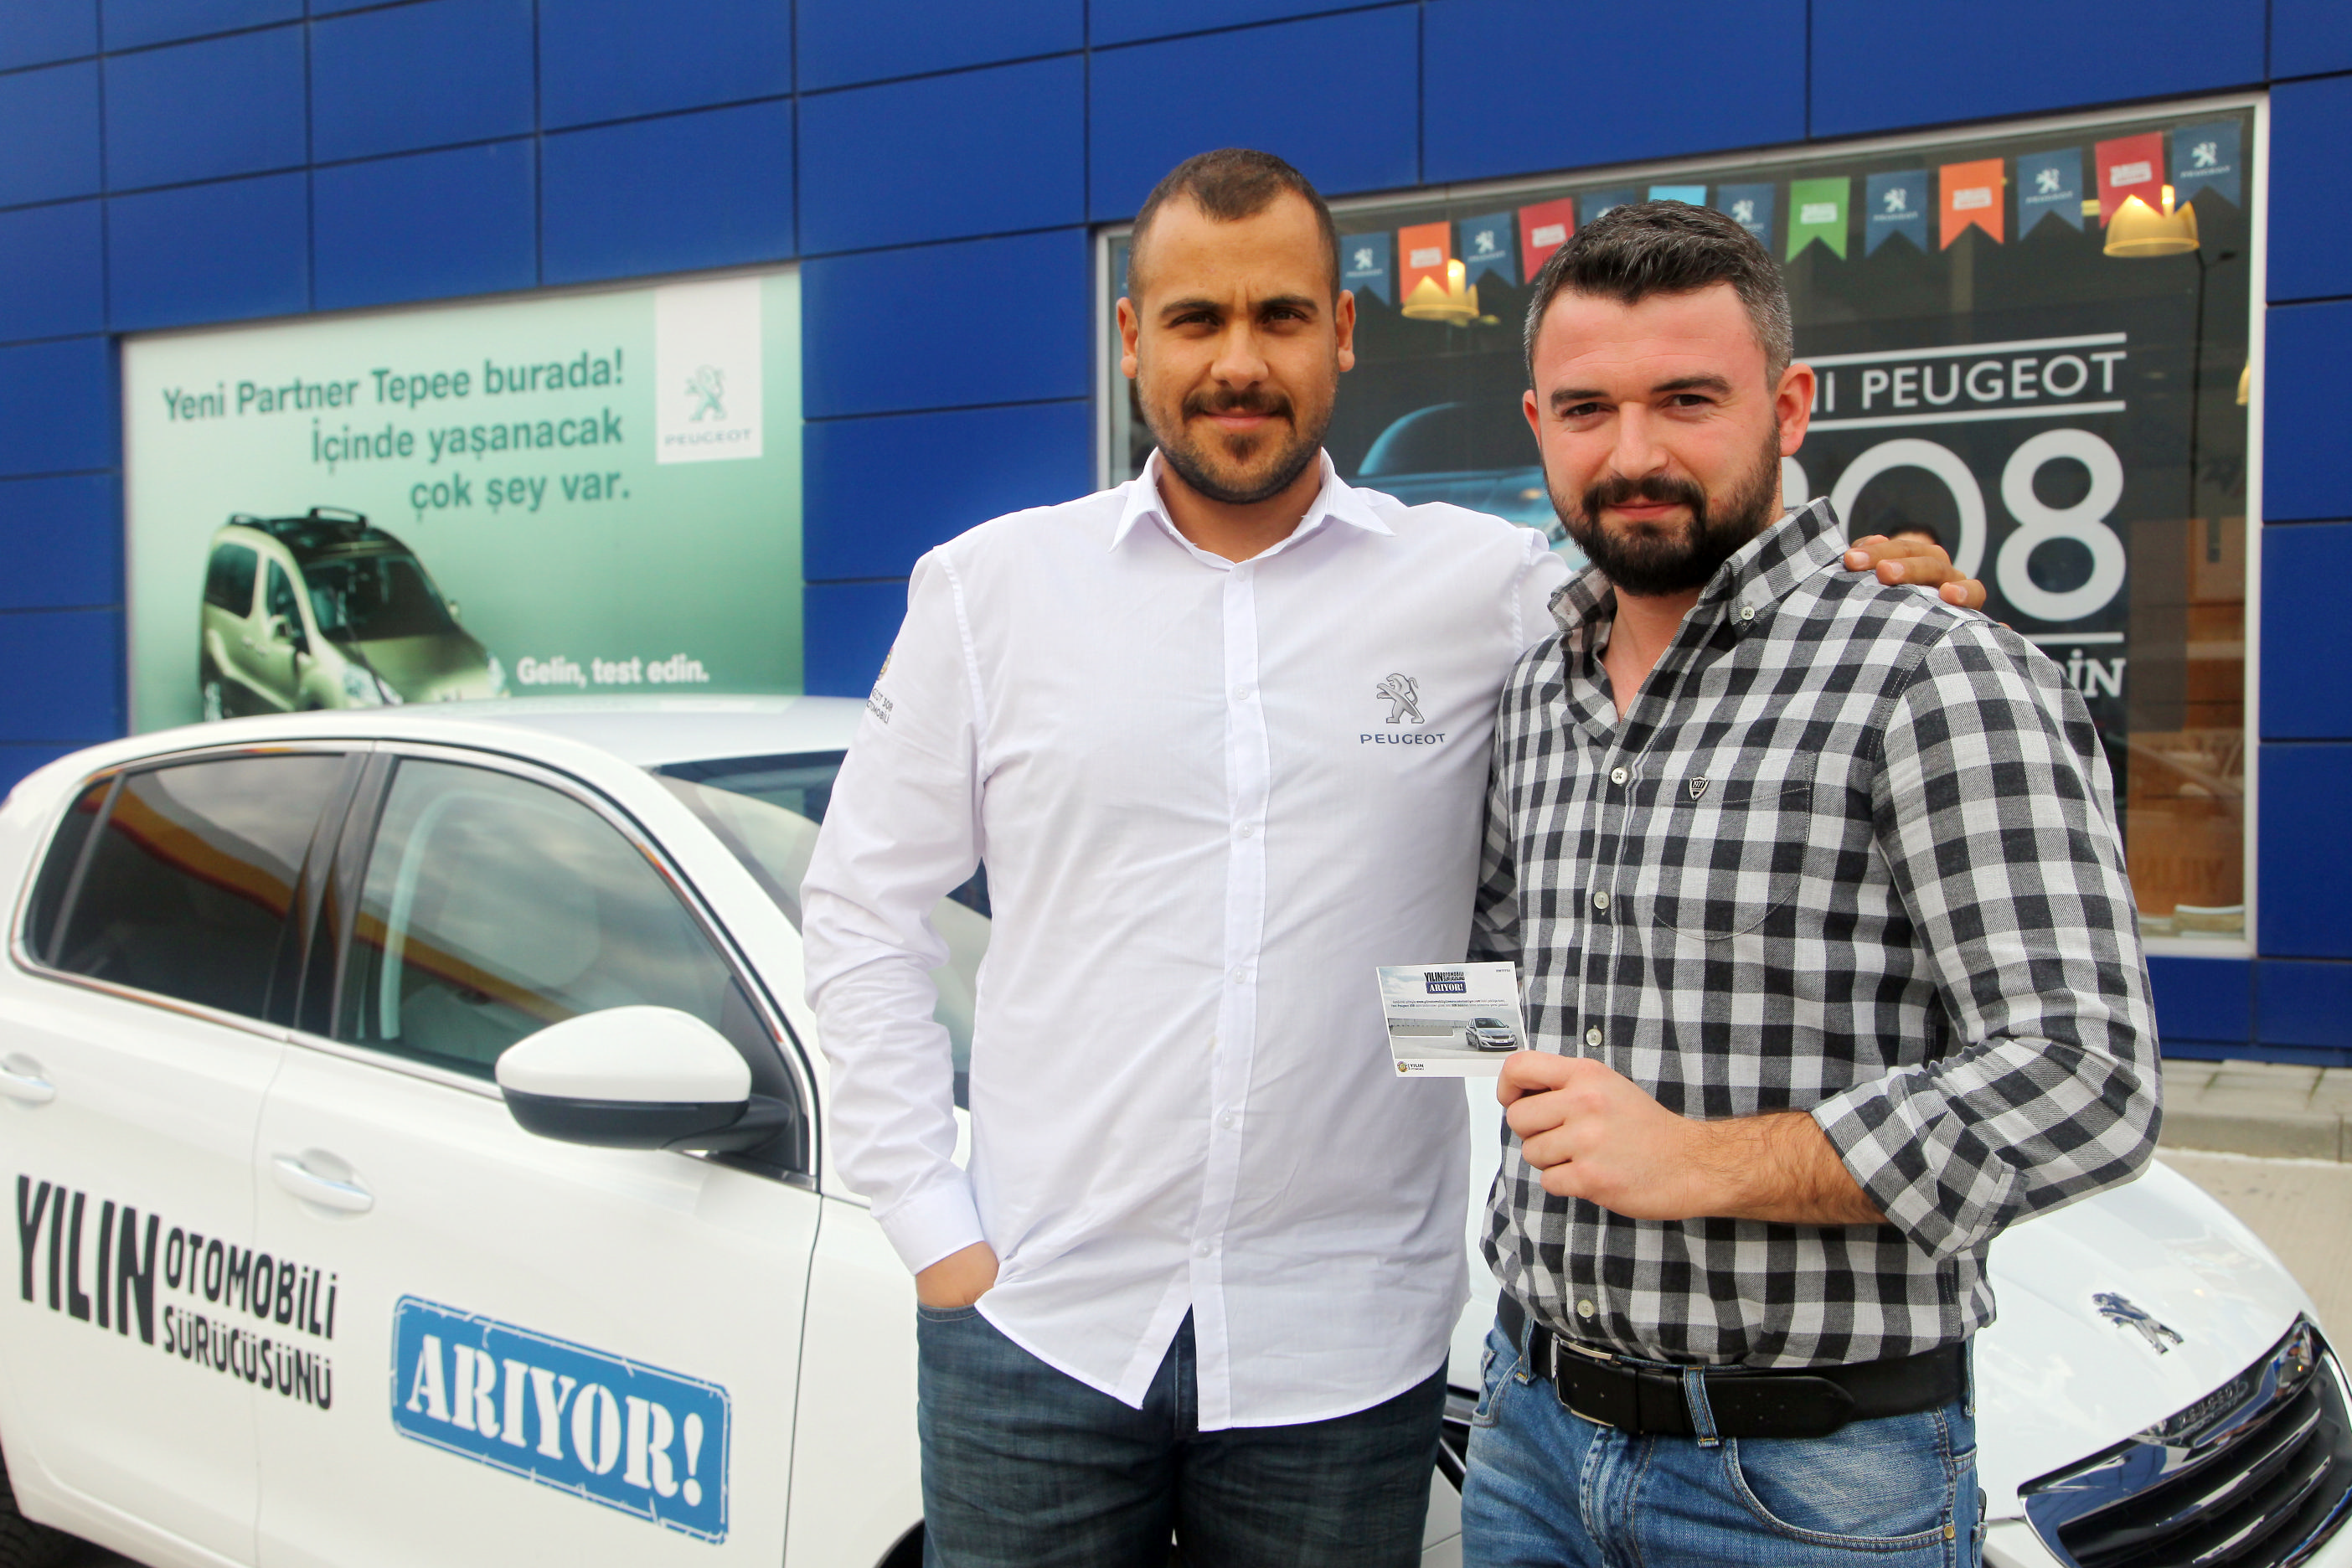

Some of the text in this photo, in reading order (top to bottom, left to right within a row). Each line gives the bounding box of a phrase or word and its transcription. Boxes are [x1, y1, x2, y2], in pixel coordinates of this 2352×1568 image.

[162, 348, 622, 420] Yeni Partner Tepee burada!
[1862, 351, 2127, 410] PEUGEOT
[312, 407, 622, 475] İçinde yaşanacak
[664, 428, 752, 446] PEUGEOT
[410, 470, 631, 521] çok şey var.
[517, 652, 709, 689] Gelin, test edin.
[1359, 733, 1446, 745] PEUGEOT
[1424, 972, 1443, 982] YILIN
[1430, 983, 1463, 992] ARIYOR!
[17, 1174, 160, 1345] YILIN
[167, 1227, 337, 1339] OTOMOBİLİ
[164, 1305, 332, 1411] SÜRÜCÜSÜNÜ
[407, 1333, 704, 1507] ARIYOR!
